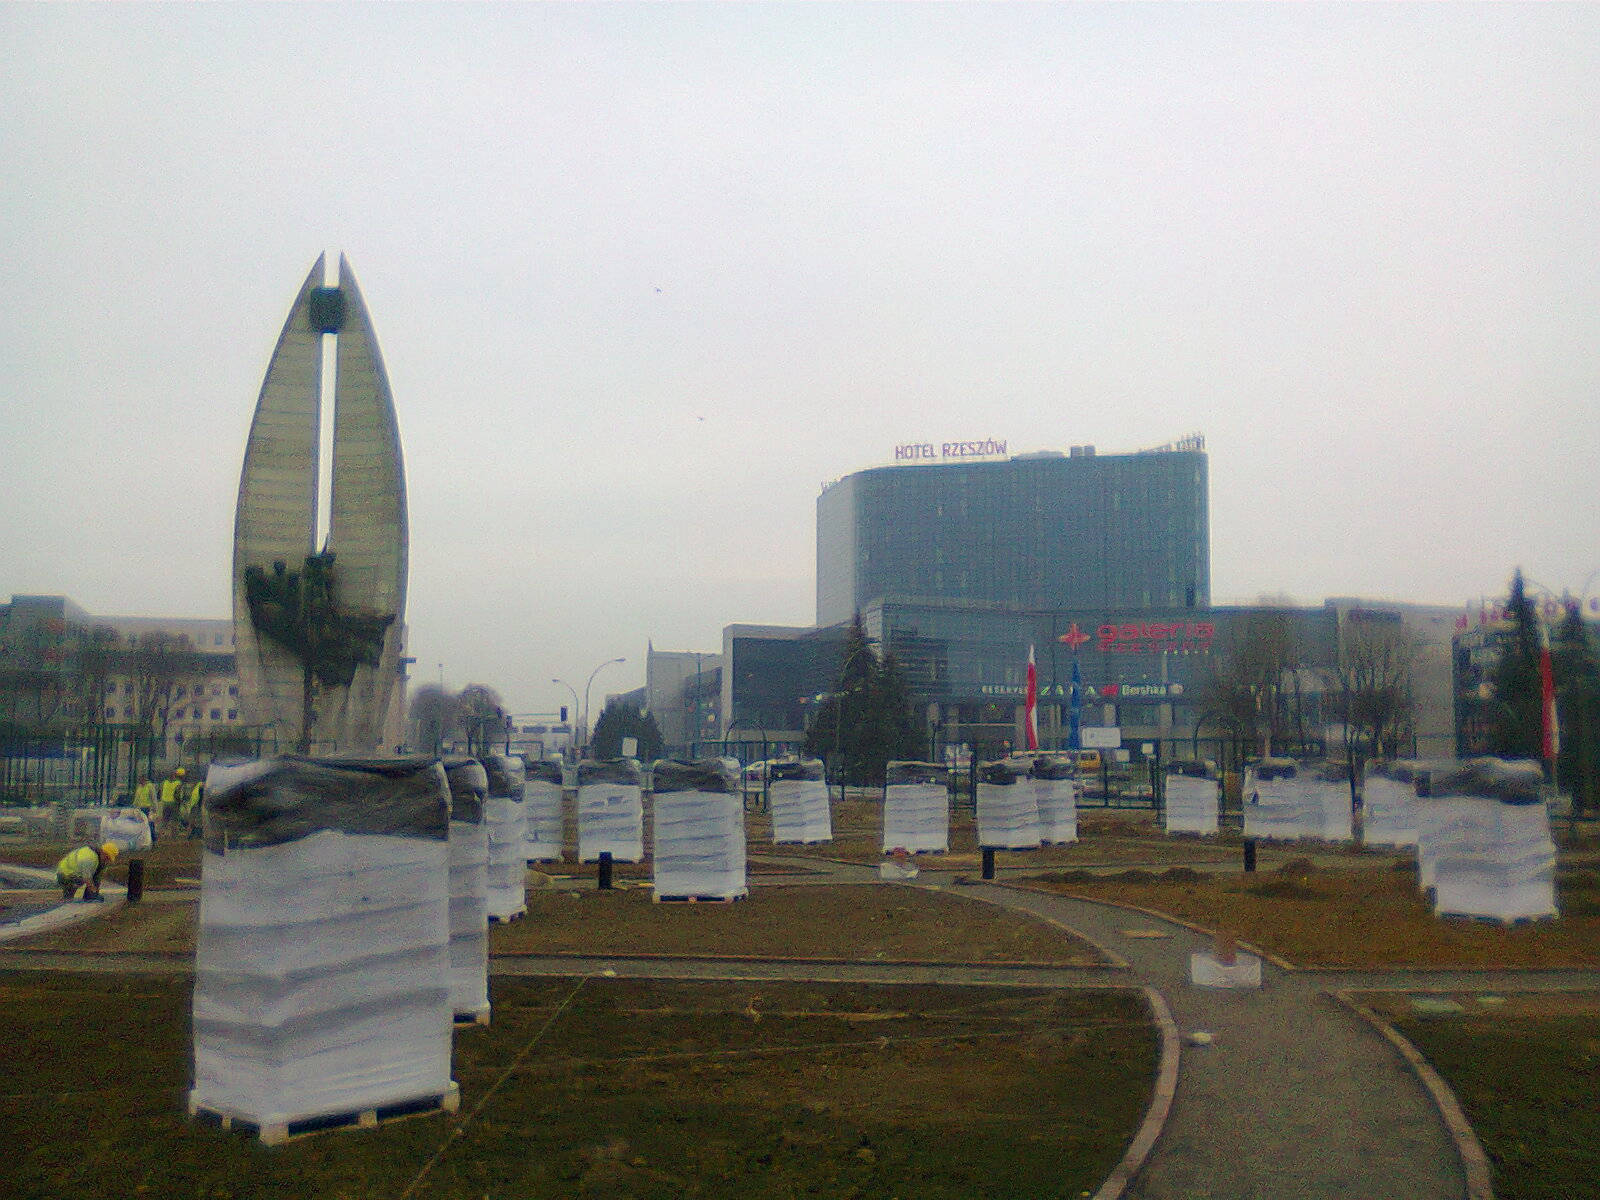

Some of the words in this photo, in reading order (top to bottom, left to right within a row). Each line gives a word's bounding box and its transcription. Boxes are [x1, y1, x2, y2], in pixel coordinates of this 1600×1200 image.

[895, 443, 938, 460] HOTEL
[942, 437, 1008, 457] RZESZÓW
[1096, 620, 1214, 642] galeria
